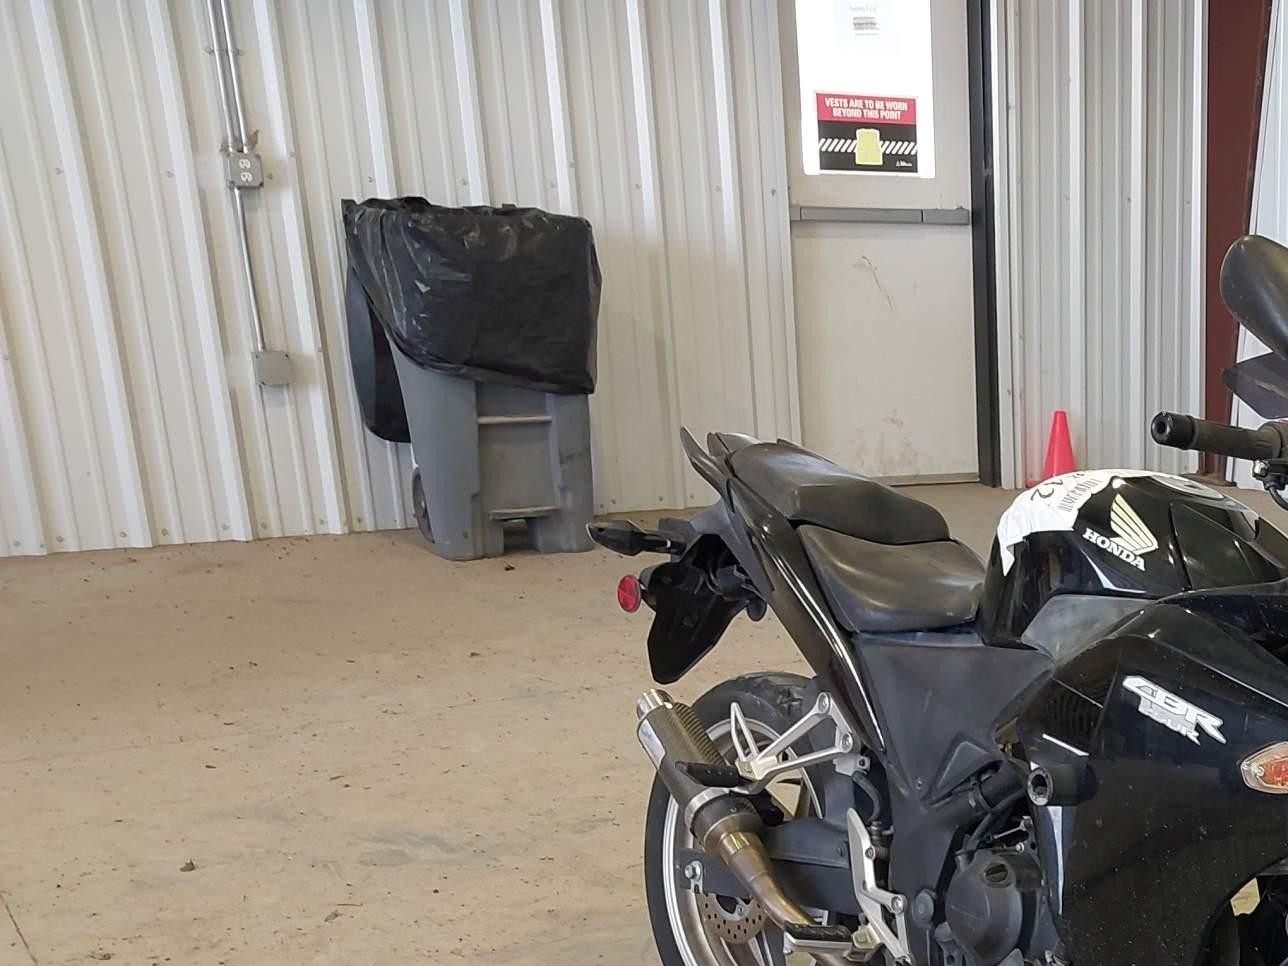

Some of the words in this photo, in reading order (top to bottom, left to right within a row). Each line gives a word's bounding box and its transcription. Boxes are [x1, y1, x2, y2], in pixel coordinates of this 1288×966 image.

[824, 97, 849, 108] VESTS
[849, 98, 864, 109] ARE
[864, 99, 874, 109] TO
[875, 100, 885, 110] BE
[886, 101, 908, 111] WORN
[832, 107, 862, 118] BEYOND
[863, 109, 879, 119] THIS
[880, 110, 902, 120] POINT
[1082, 528, 1146, 572] HONDA
